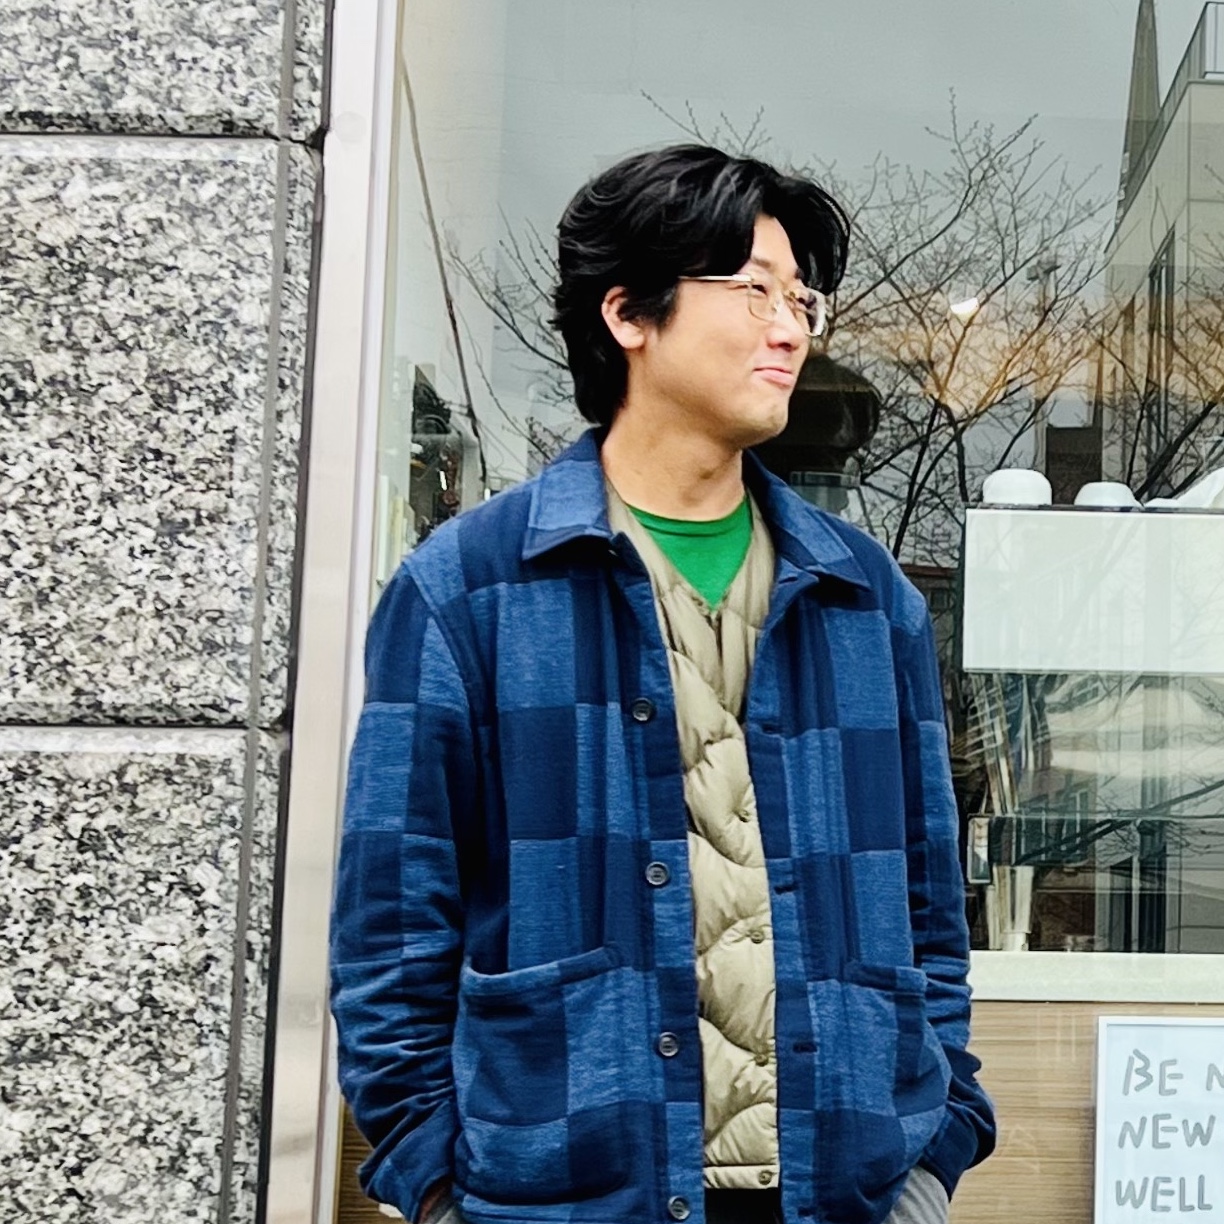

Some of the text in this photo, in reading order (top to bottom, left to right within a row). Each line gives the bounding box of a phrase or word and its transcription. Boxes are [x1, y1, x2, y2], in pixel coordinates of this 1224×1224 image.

[1122, 1049, 1183, 1096] BE
[1118, 1113, 1216, 1149] NEW
[1115, 1176, 1213, 1212] WELL
